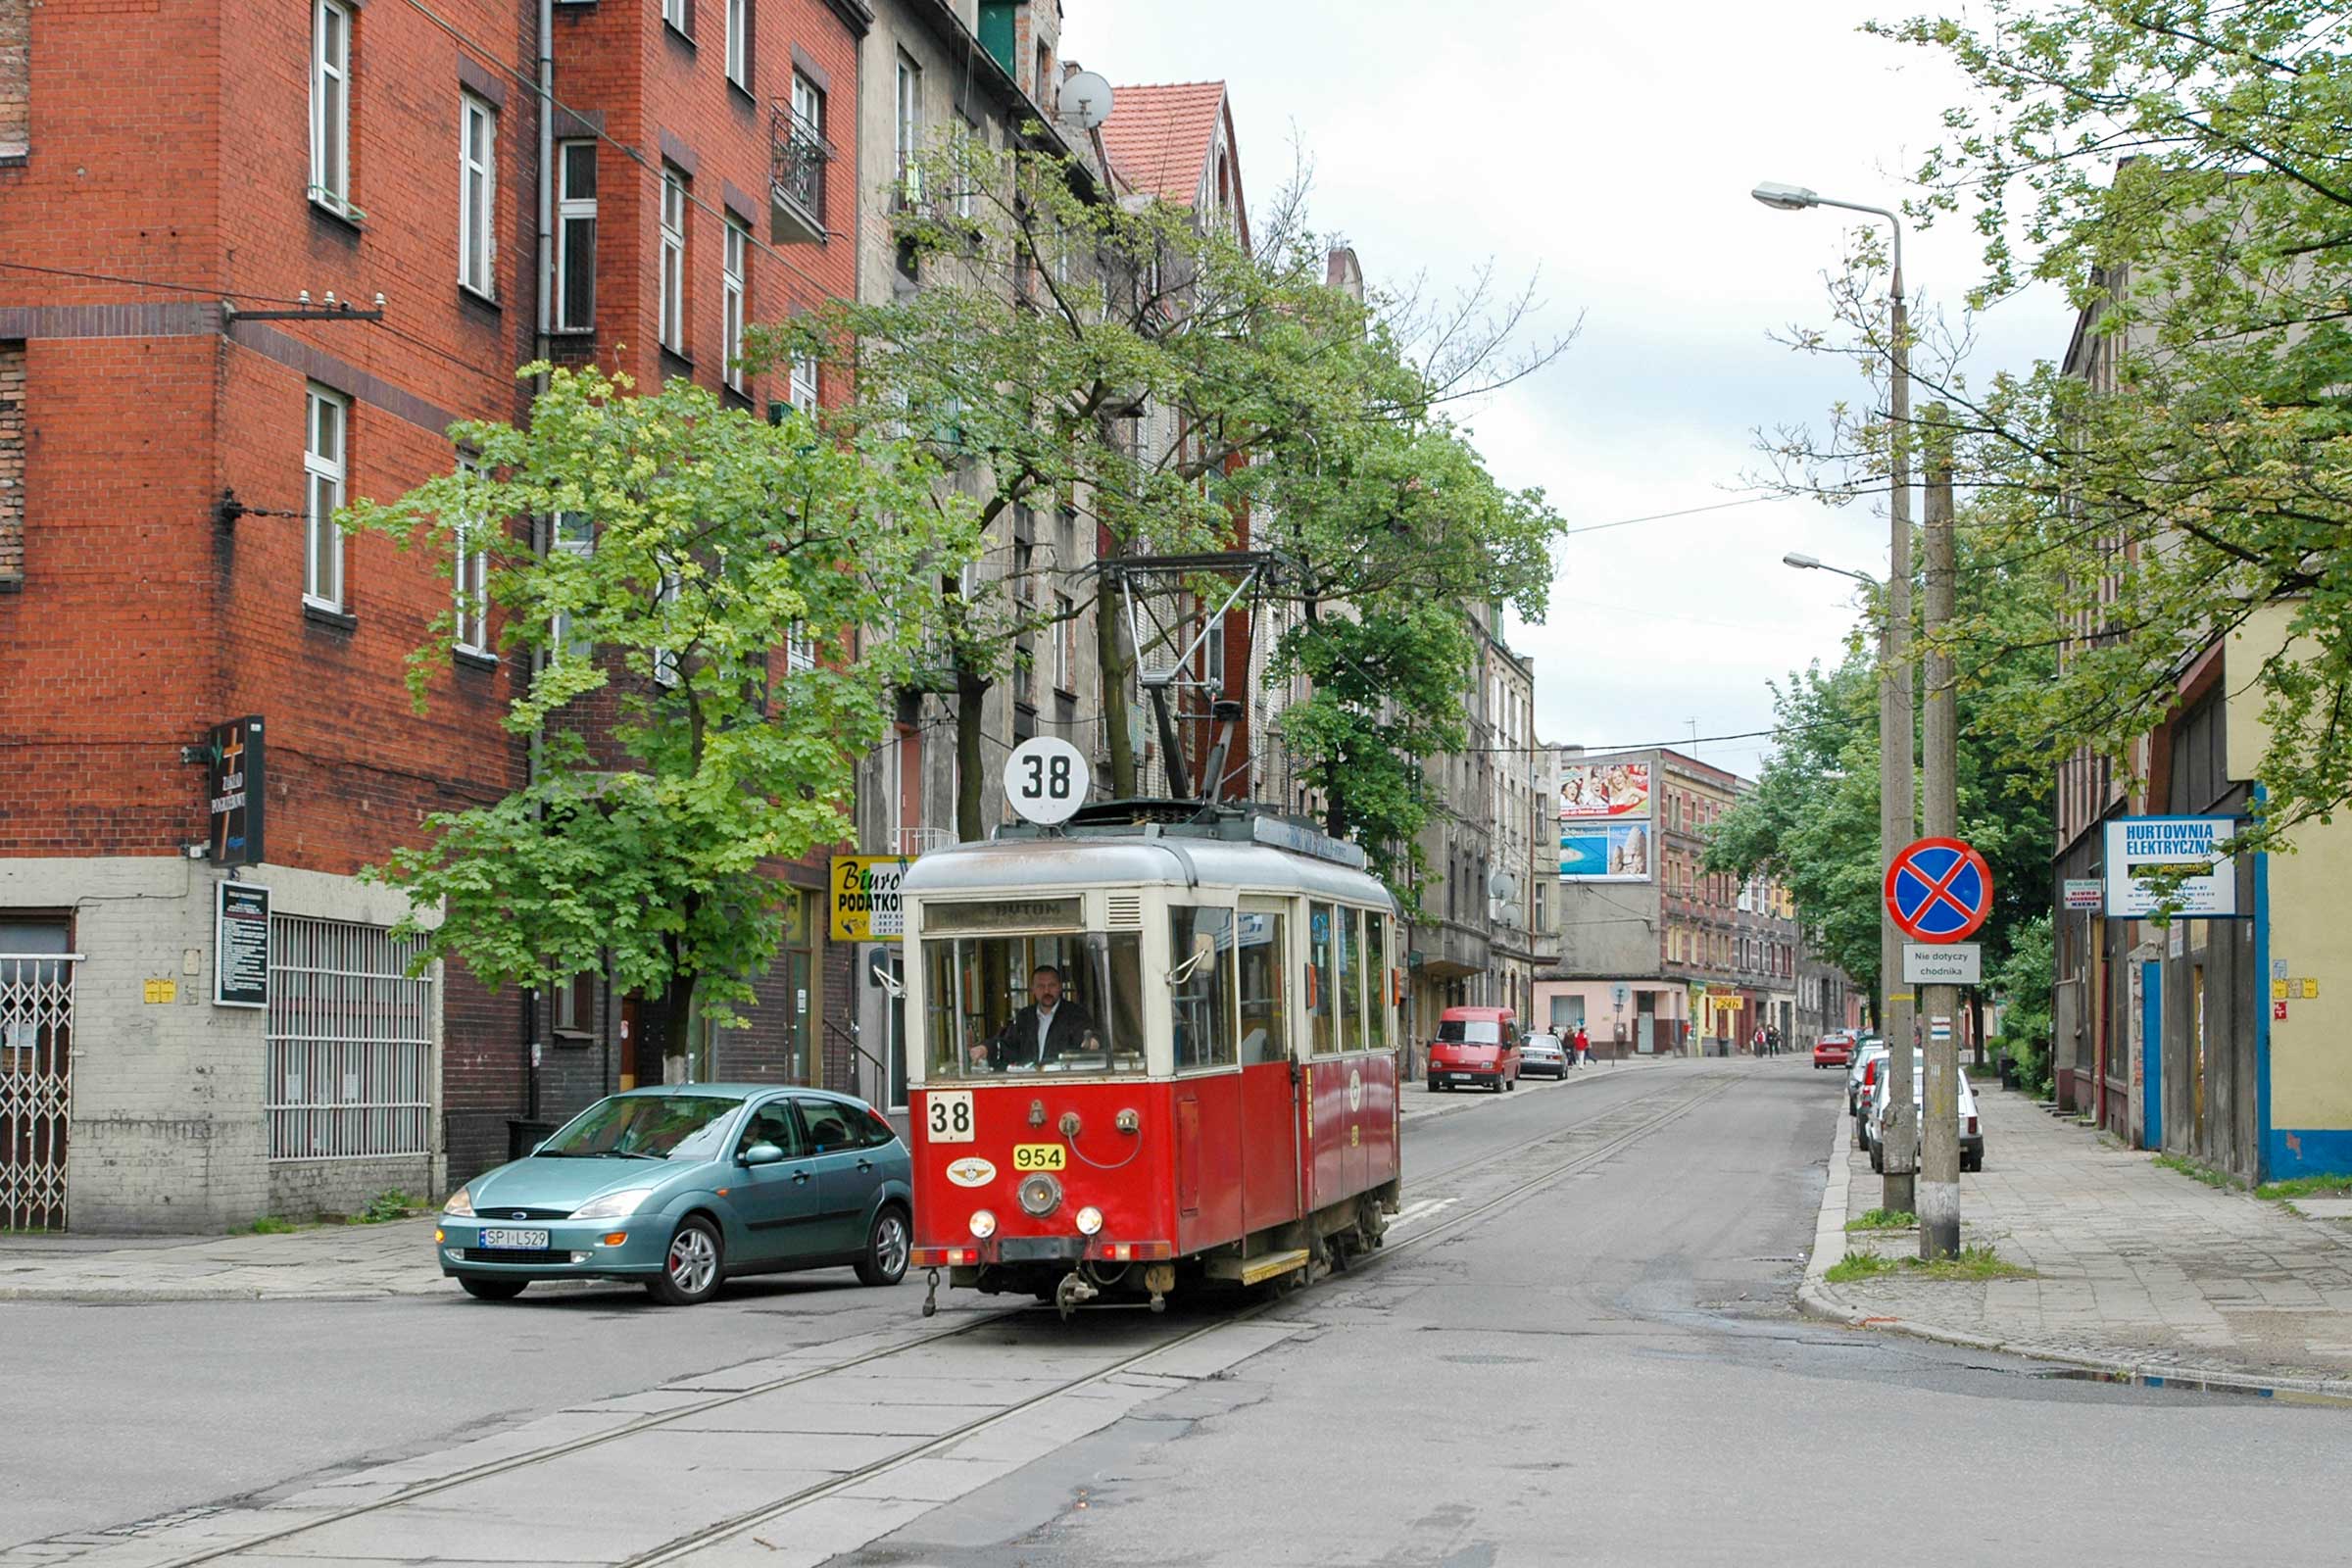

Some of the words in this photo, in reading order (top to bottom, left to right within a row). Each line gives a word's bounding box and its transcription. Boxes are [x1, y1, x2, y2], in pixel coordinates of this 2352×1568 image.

[1022, 755, 1070, 799] 38
[2127, 824, 2214, 839] HURTOWNIA
[2127, 840, 2214, 855] ELEKTRYCZNA
[837, 860, 901, 891] Biuro
[839, 893, 903, 911] PODATKO
[1933, 953, 1968, 961] dotyczy
[931, 1102, 970, 1133] 38
[1016, 1149, 1062, 1167] 954
[516, 1231, 546, 1246] L529
